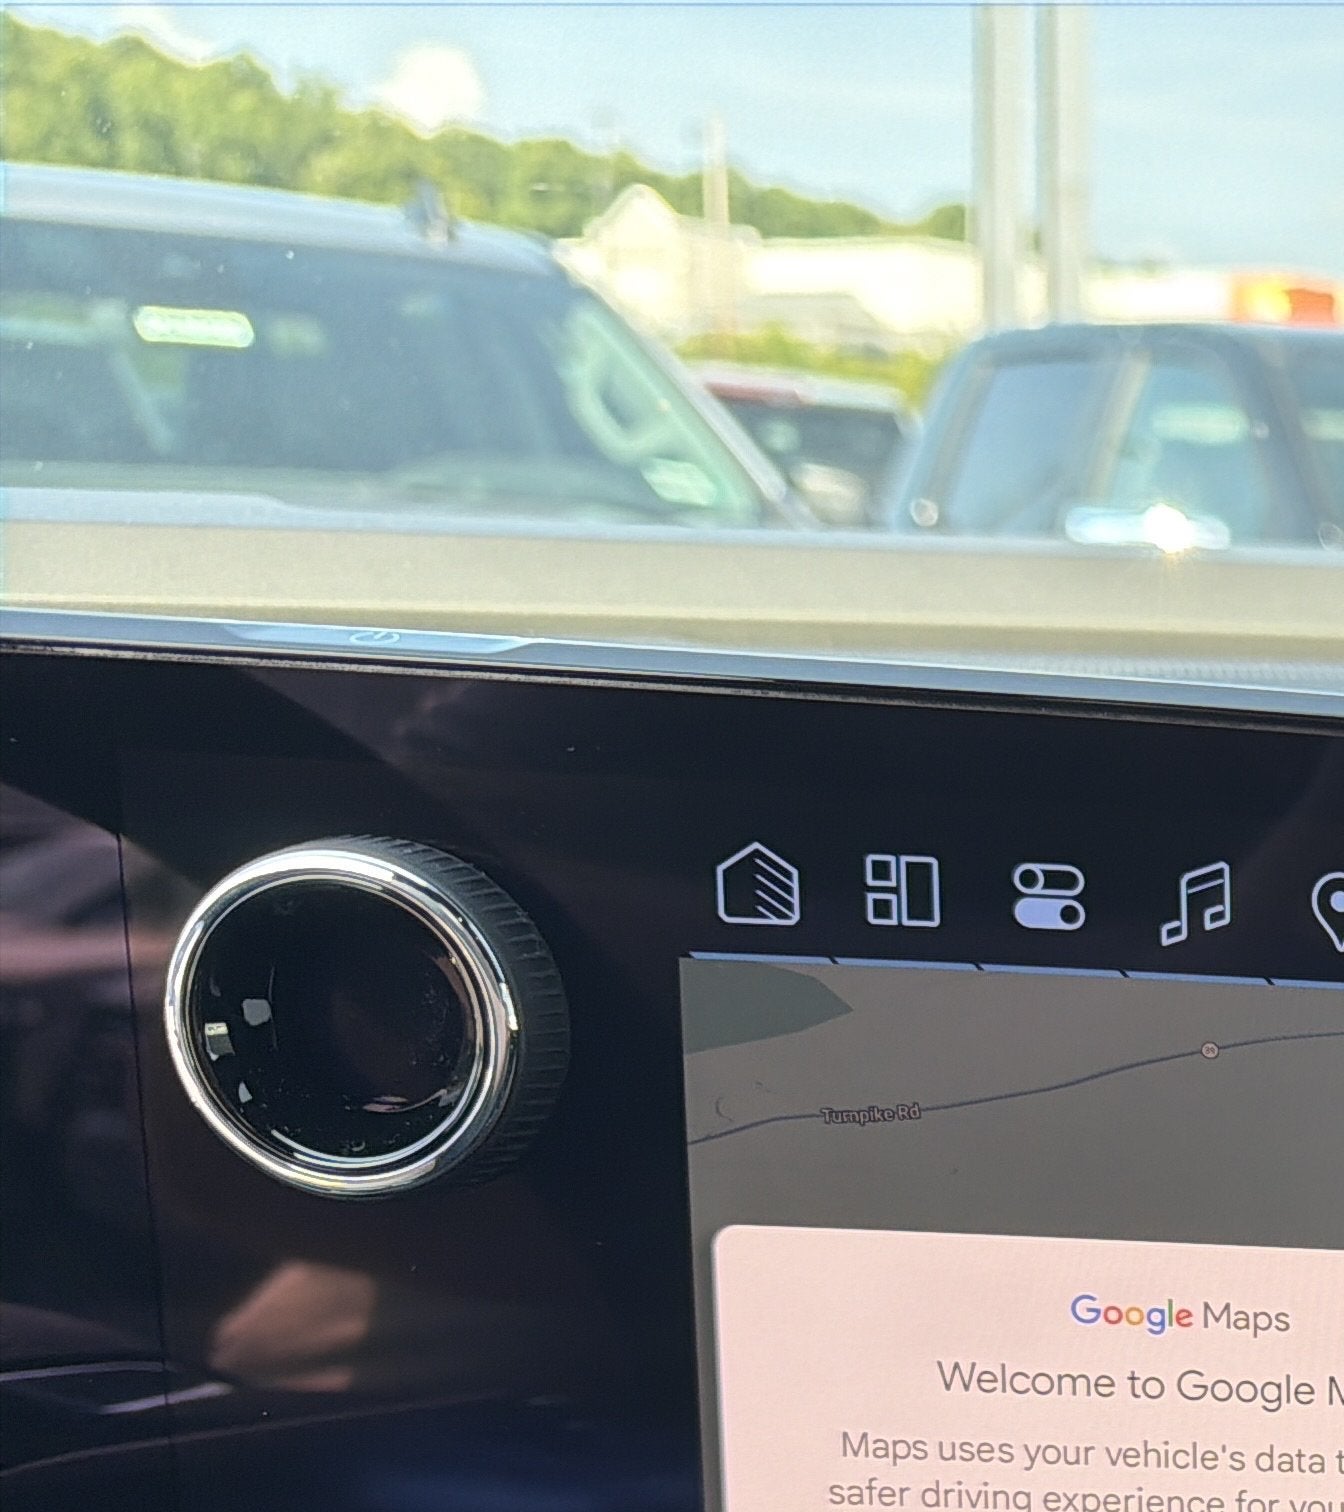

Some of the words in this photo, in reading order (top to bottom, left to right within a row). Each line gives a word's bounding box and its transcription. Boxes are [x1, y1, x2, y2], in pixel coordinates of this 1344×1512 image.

[820, 1106, 895, 1126] Turnpike
[896, 1102, 921, 1121] Rd
[1071, 1295, 1193, 1335] Google
[1204, 1302, 1290, 1338] Maps
[937, 1361, 1115, 1397] Welcome
[1127, 1371, 1164, 1399] to
[1177, 1370, 1315, 1412] Google
[843, 1432, 928, 1466] Maps
[939, 1441, 1014, 1463] uses
[1024, 1444, 1095, 1471] your
[1105, 1440, 1245, 1471] vehicle's
[1256, 1444, 1325, 1473] data
[829, 1477, 910, 1506] safer
